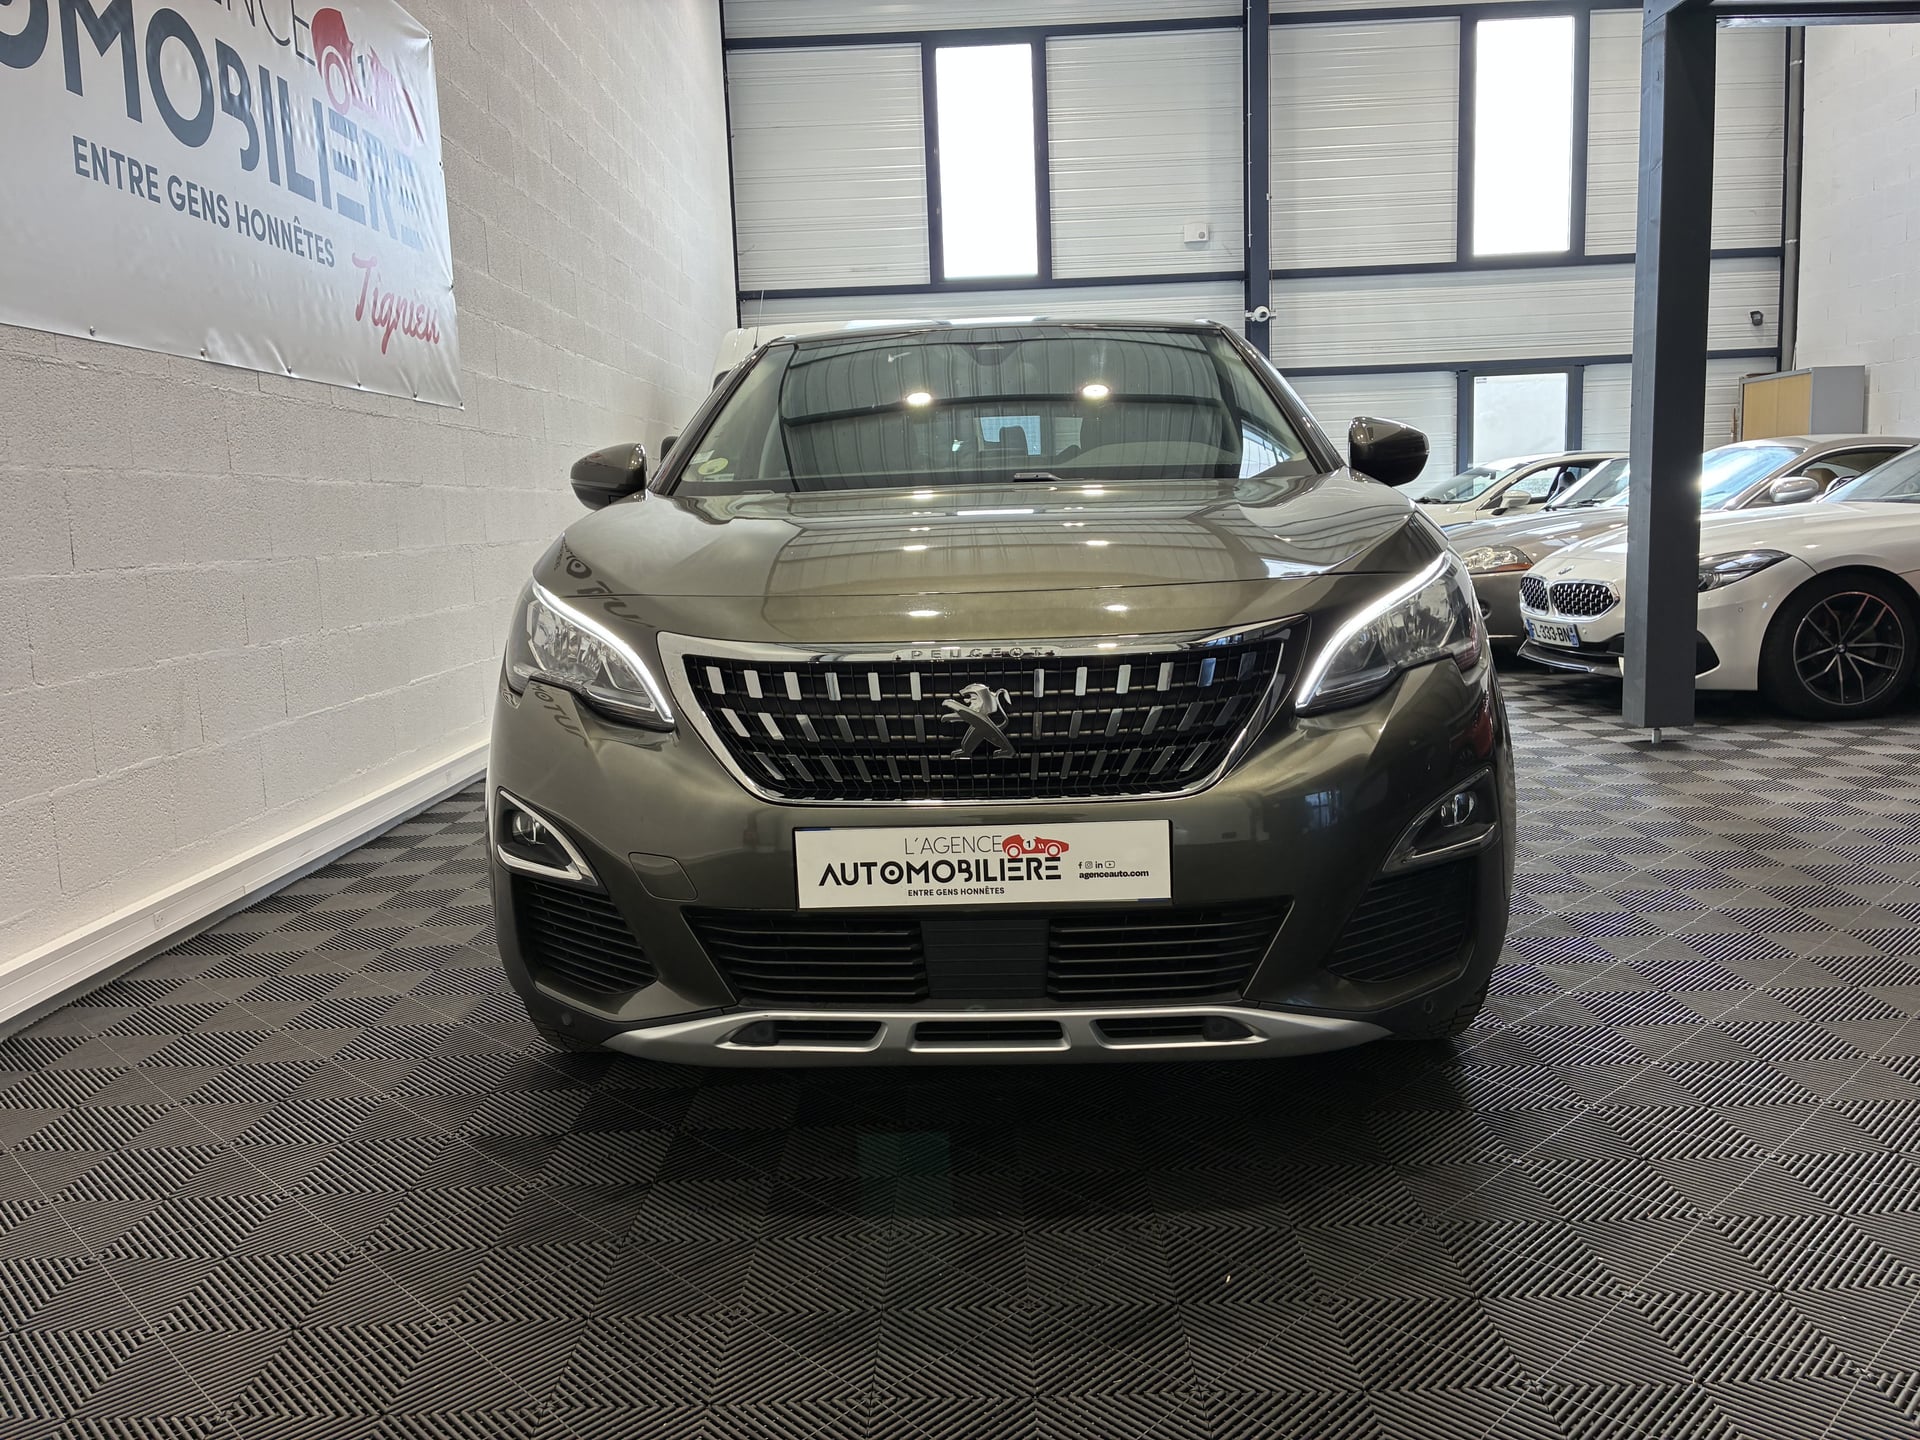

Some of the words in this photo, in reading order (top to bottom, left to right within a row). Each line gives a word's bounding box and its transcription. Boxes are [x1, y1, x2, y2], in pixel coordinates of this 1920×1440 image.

[72, 135, 161, 204] ENTRE
[167, 174, 230, 229] GENS
[235, 201, 336, 268] HONNÊTES
[352, 252, 440, 355] Tignieu
[911, 647, 1043, 660] PEUGEOT
[904, 835, 1003, 854] L'AGENCE
[1079, 870, 1150, 880] agenceauto.com
[908, 889, 935, 897] ENTRE
[936, 888, 959, 896] GENS
[960, 886, 1005, 895] HONNÊTES
